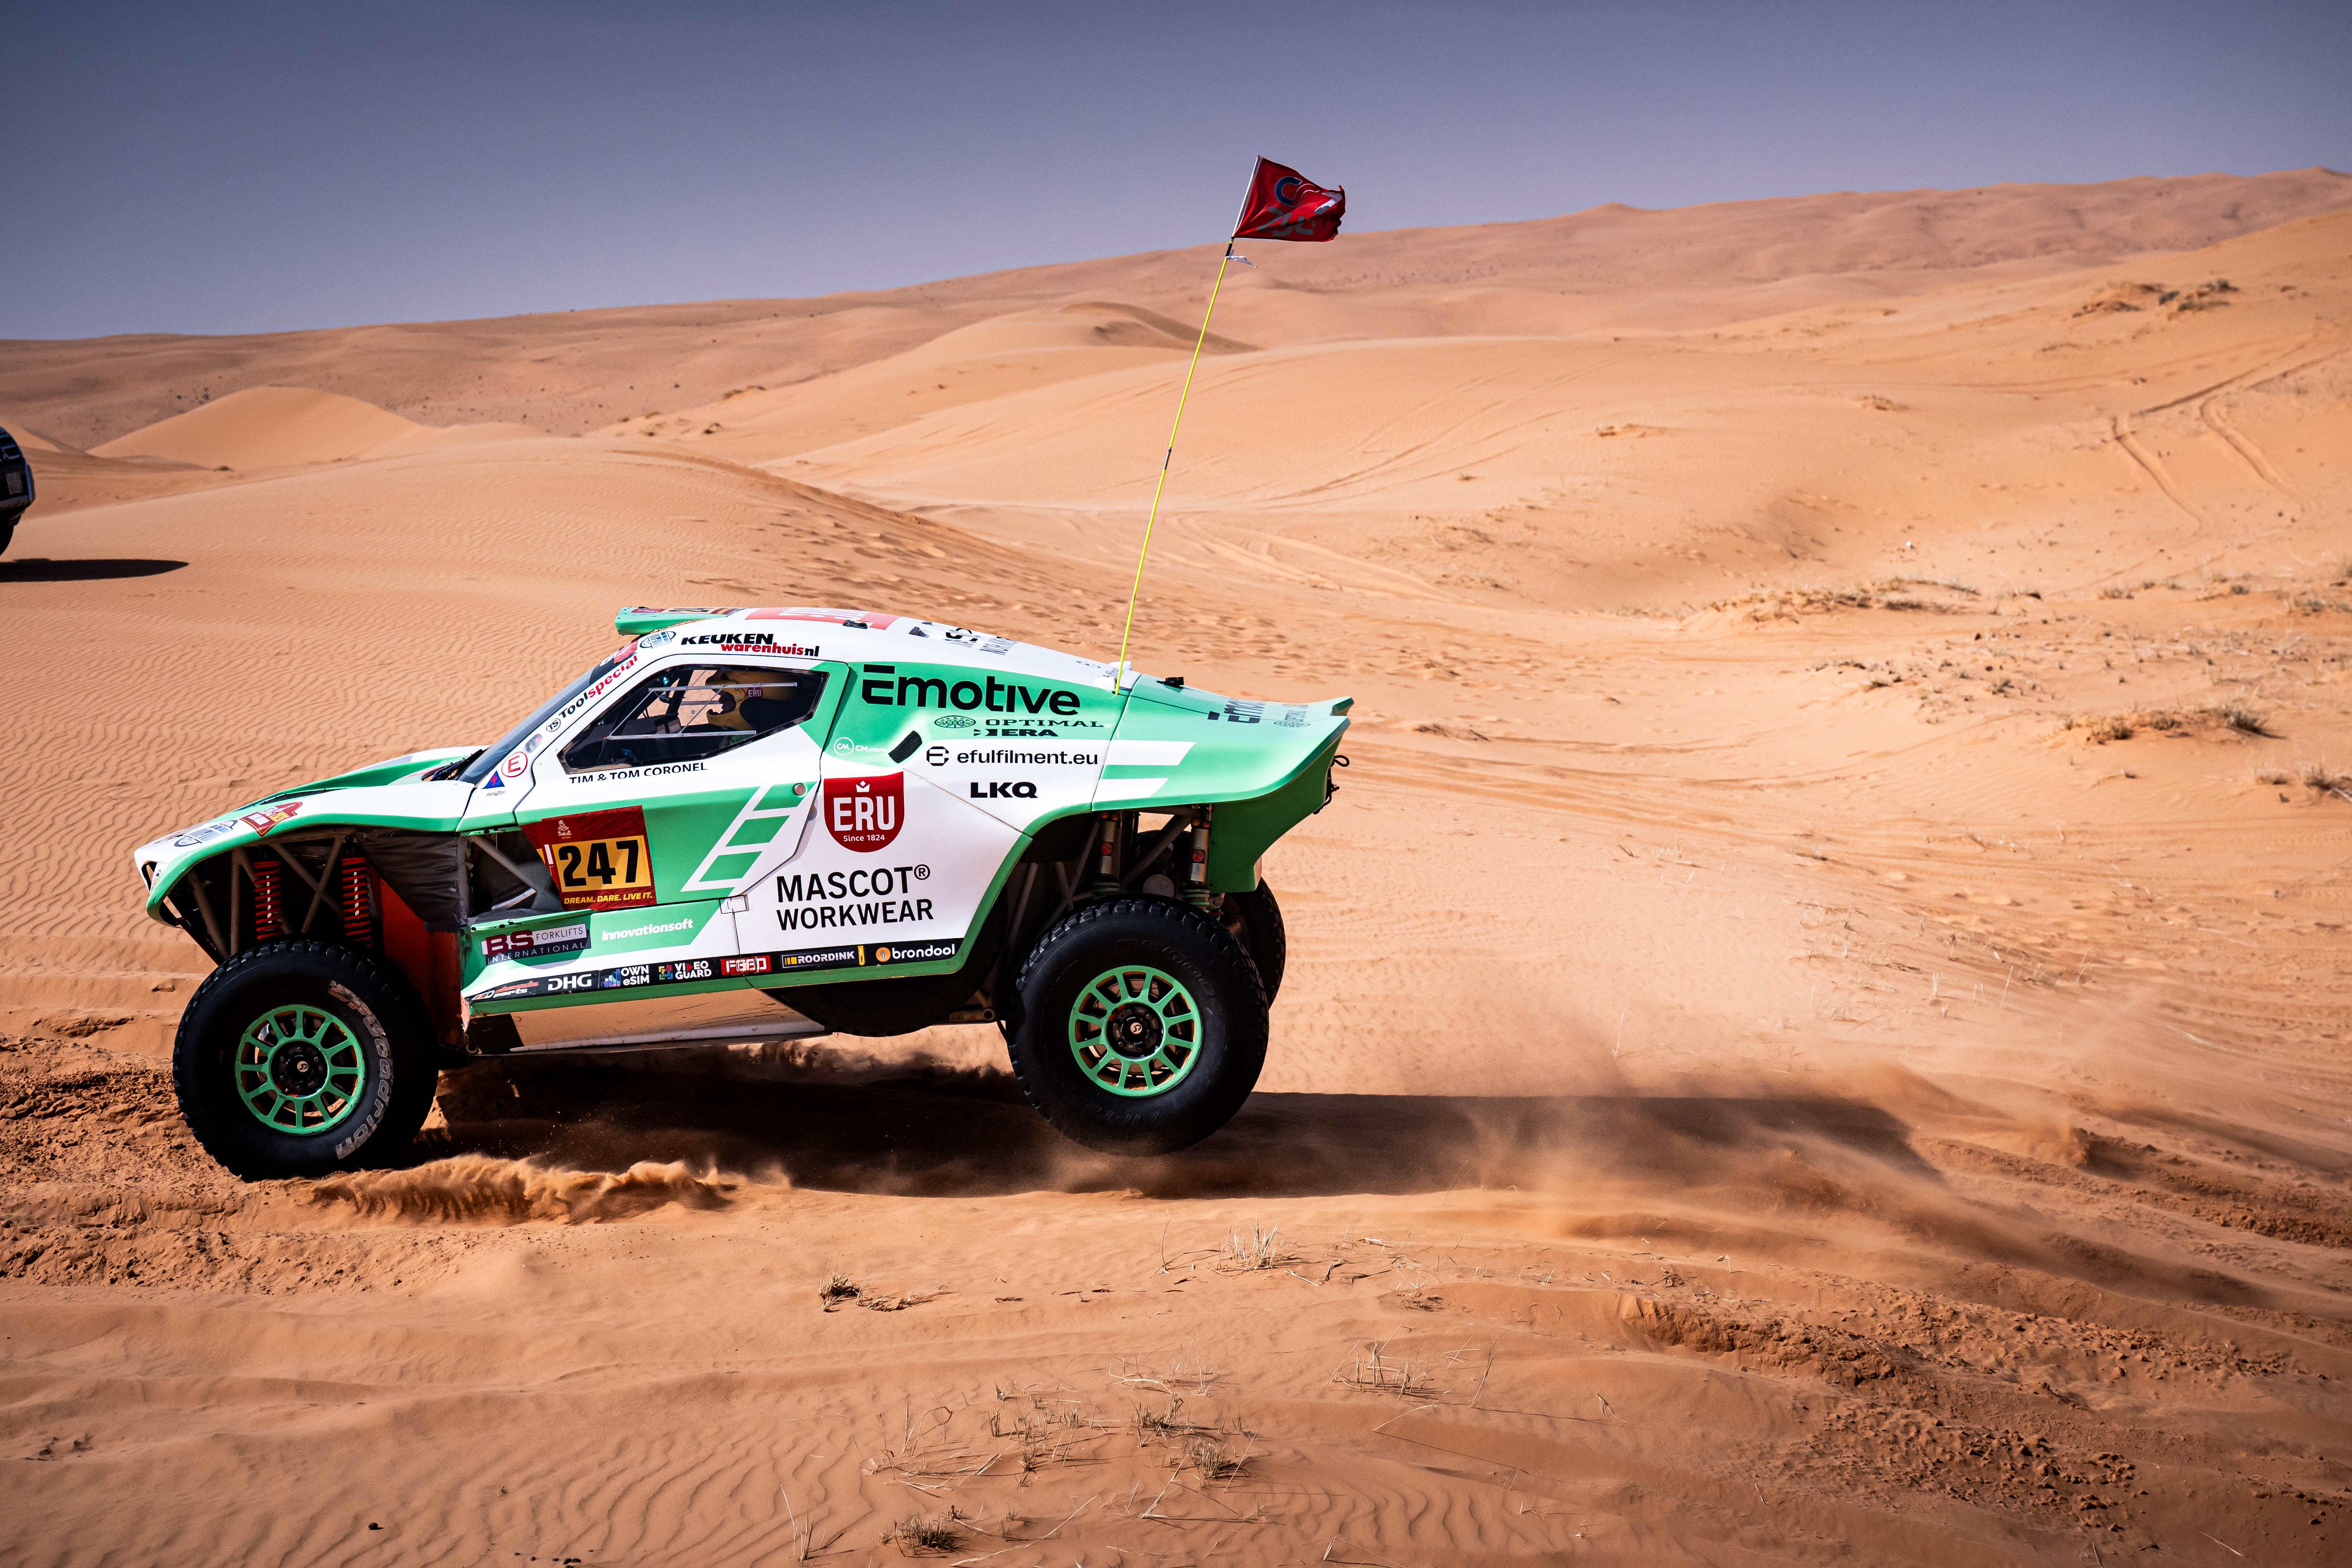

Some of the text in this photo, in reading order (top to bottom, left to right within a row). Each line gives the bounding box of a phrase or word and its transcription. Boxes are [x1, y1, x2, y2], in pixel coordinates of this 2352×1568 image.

[681, 633, 773, 645] KEUKEN
[558, 655, 638, 718] Toolspecial
[748, 689, 762, 697] ERU
[862, 664, 1080, 716] Emotive
[985, 719, 1103, 728] OPTIMAL
[957, 750, 1098, 765] efulfilment.eu
[569, 775, 593, 784] TIM
[610, 769, 639, 780] TOM
[644, 762, 707, 776] CORONEL
[970, 782, 1038, 799] LKQ
[833, 796, 895, 831] ERU
[558, 839, 639, 887] 247
[564, 896, 595, 904] DREAM.
[597, 894, 621, 902] DARE.
[776, 898, 934, 931] WORKWEAR
[602, 918, 693, 941] Innovationsoft
[485, 927, 583, 956] BS FORKLIFTS
[488, 943, 585, 964] INTERNATIONAL
[798, 951, 855, 964] ROORDINK
[892, 944, 955, 959] brondool
[621, 965, 649, 976] OWN
[675, 968, 712, 980] GUARD
[548, 973, 592, 991] DHG
[622, 975, 650, 986] eSIM
[493, 988, 528, 998] parts
